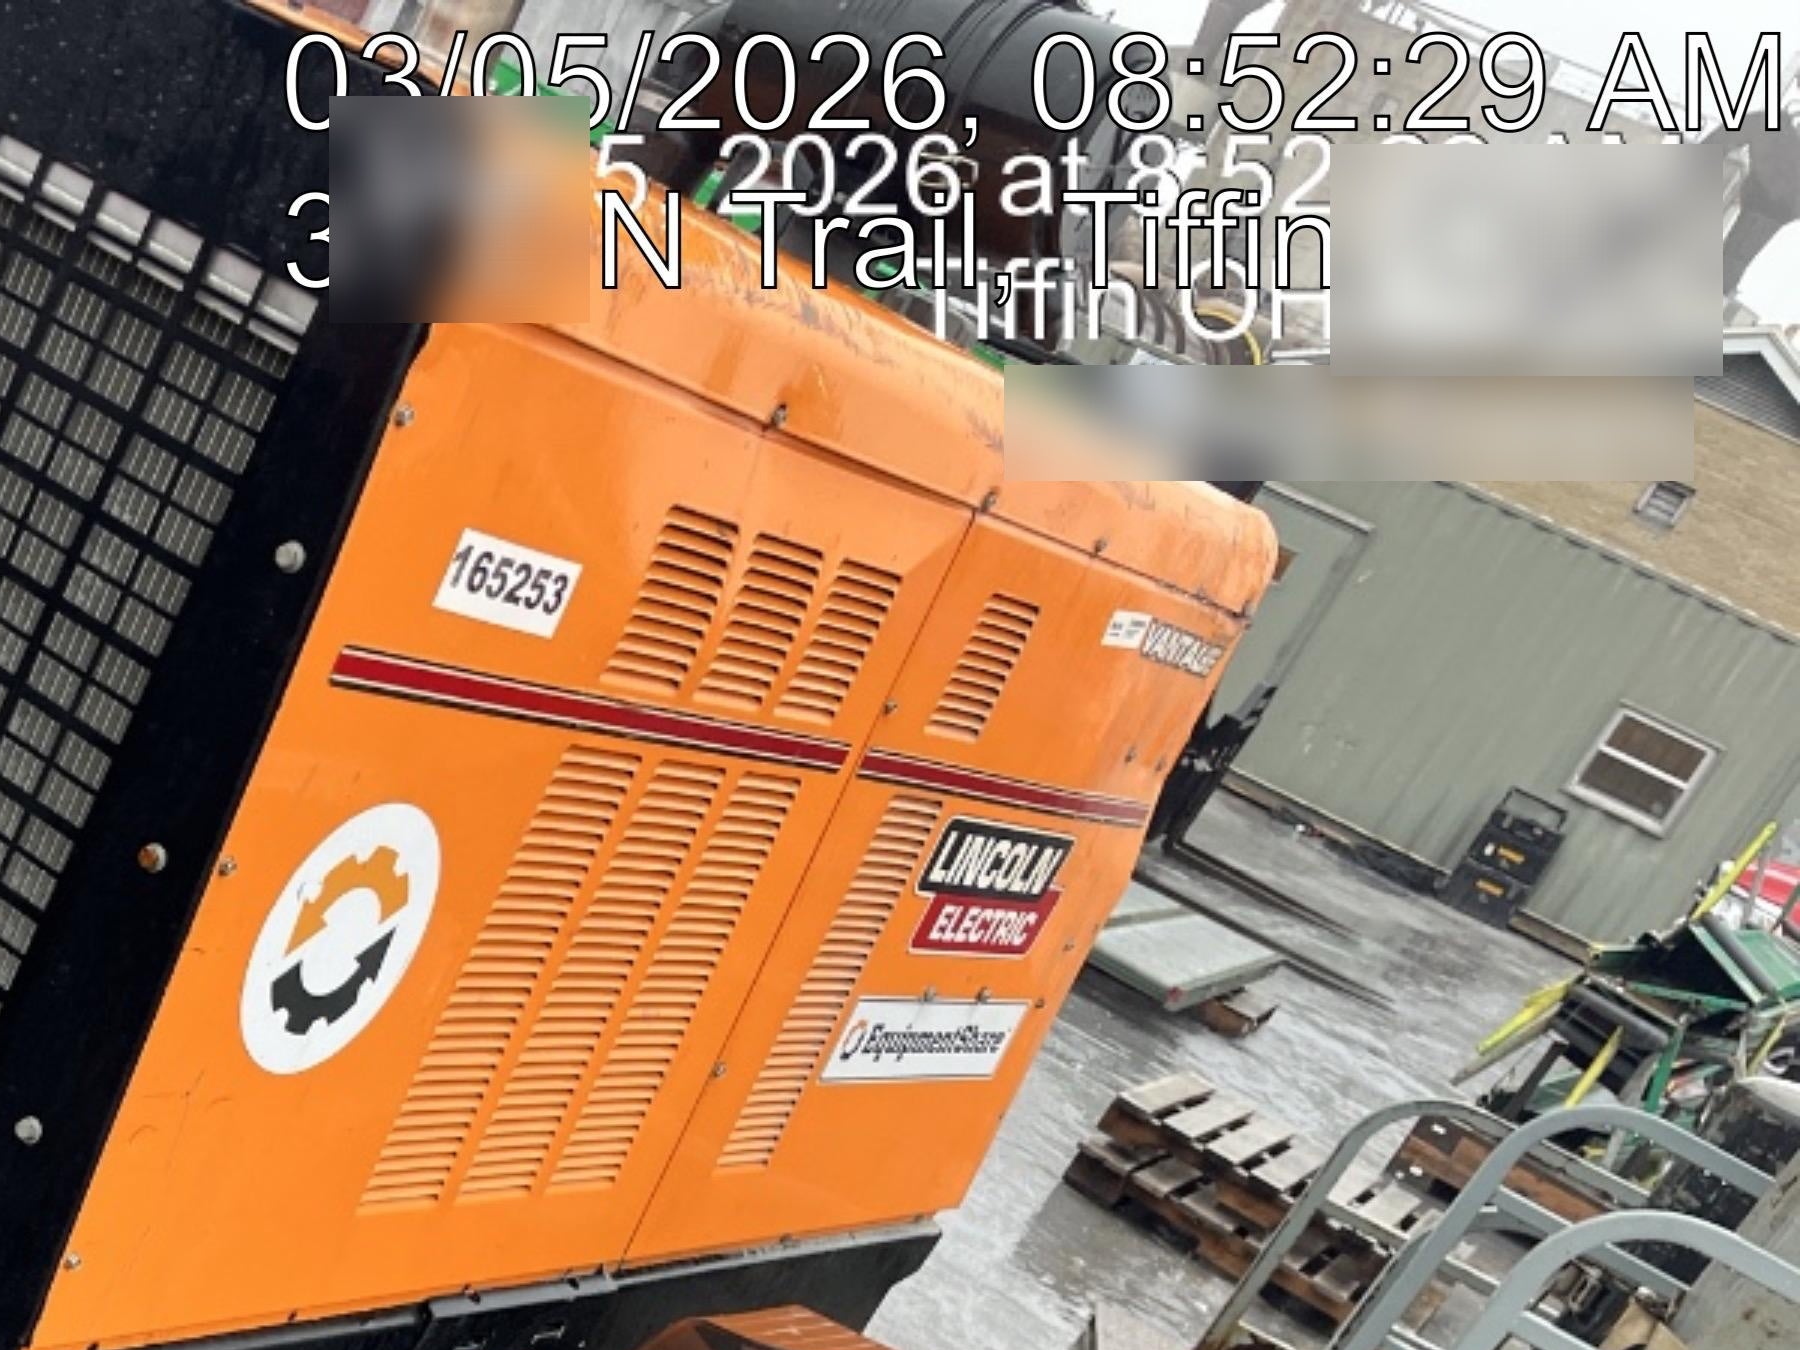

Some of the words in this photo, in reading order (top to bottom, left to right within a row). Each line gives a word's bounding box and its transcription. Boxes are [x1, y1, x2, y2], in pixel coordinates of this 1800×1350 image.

[449, 545, 569, 615] 165253
[928, 830, 1063, 895] LINCOLN
[928, 904, 1039, 946] ELECTRIC
[861, 1023, 1006, 1062] EquipmentShare
